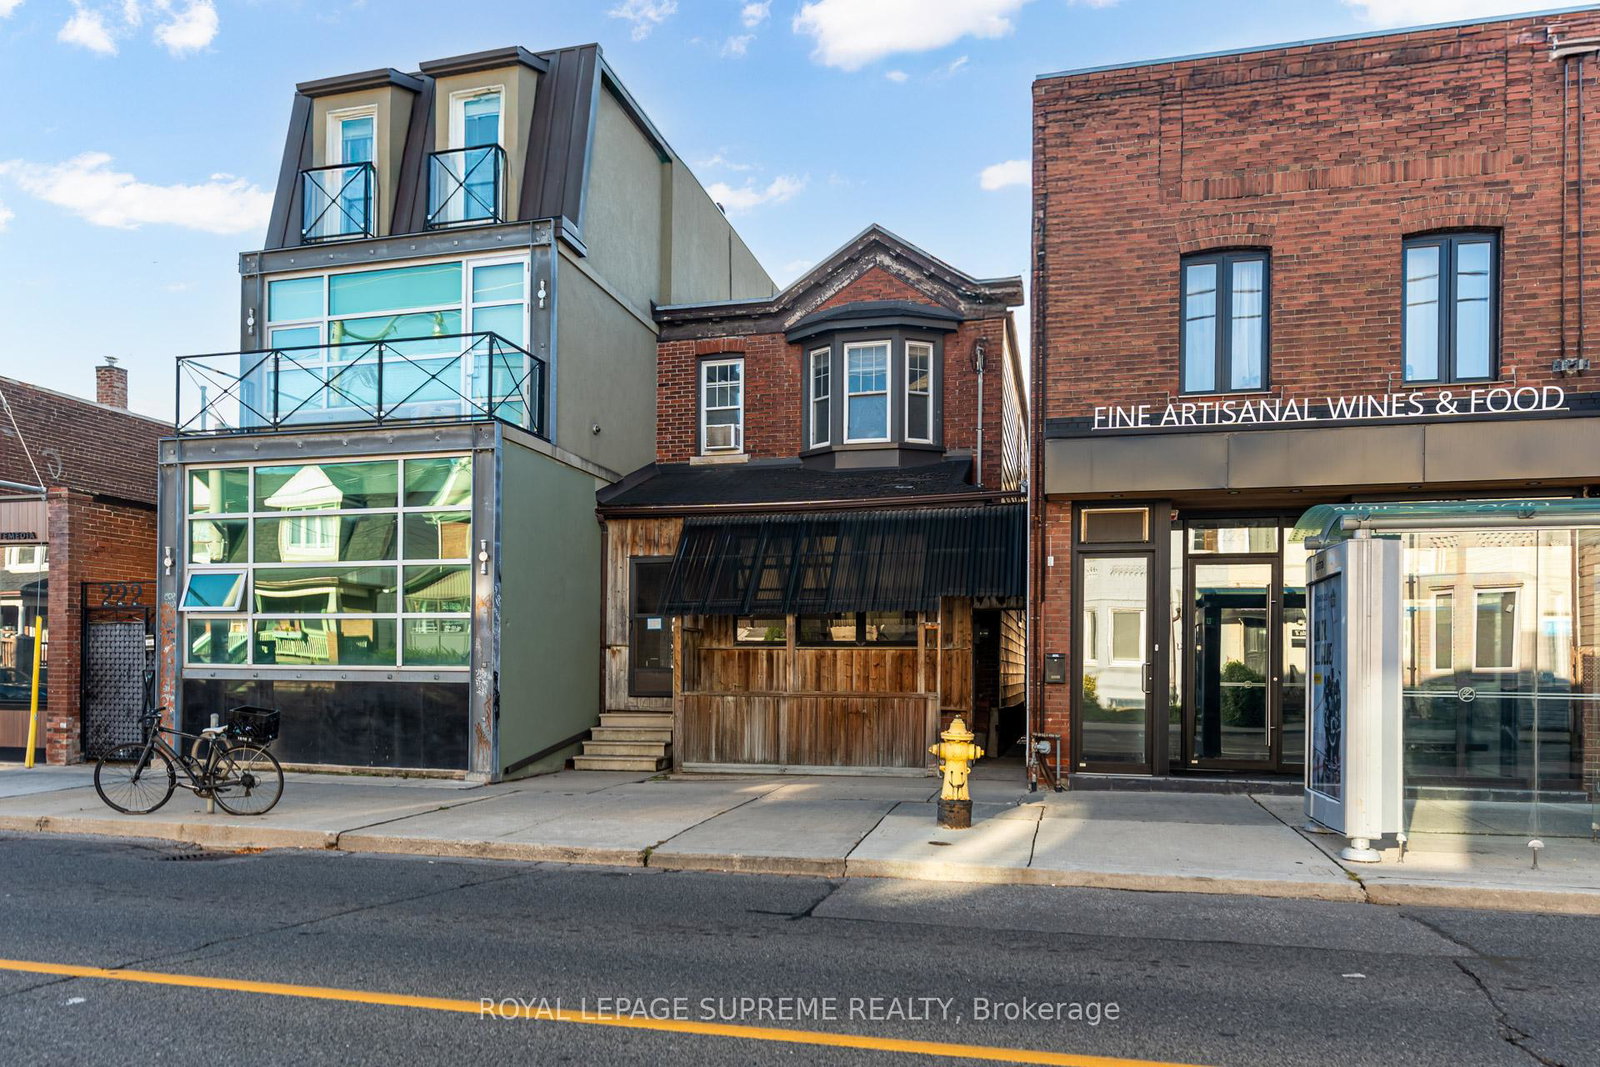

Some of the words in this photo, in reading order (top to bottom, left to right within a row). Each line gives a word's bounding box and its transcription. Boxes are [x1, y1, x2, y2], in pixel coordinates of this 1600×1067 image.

[1094, 404, 1151, 429] FINE
[1160, 398, 1317, 426] ARTISANAL
[1326, 392, 1424, 419] WINES
[1435, 390, 1458, 415] &
[1470, 385, 1565, 413] FOOD
[101, 582, 143, 608] 222
